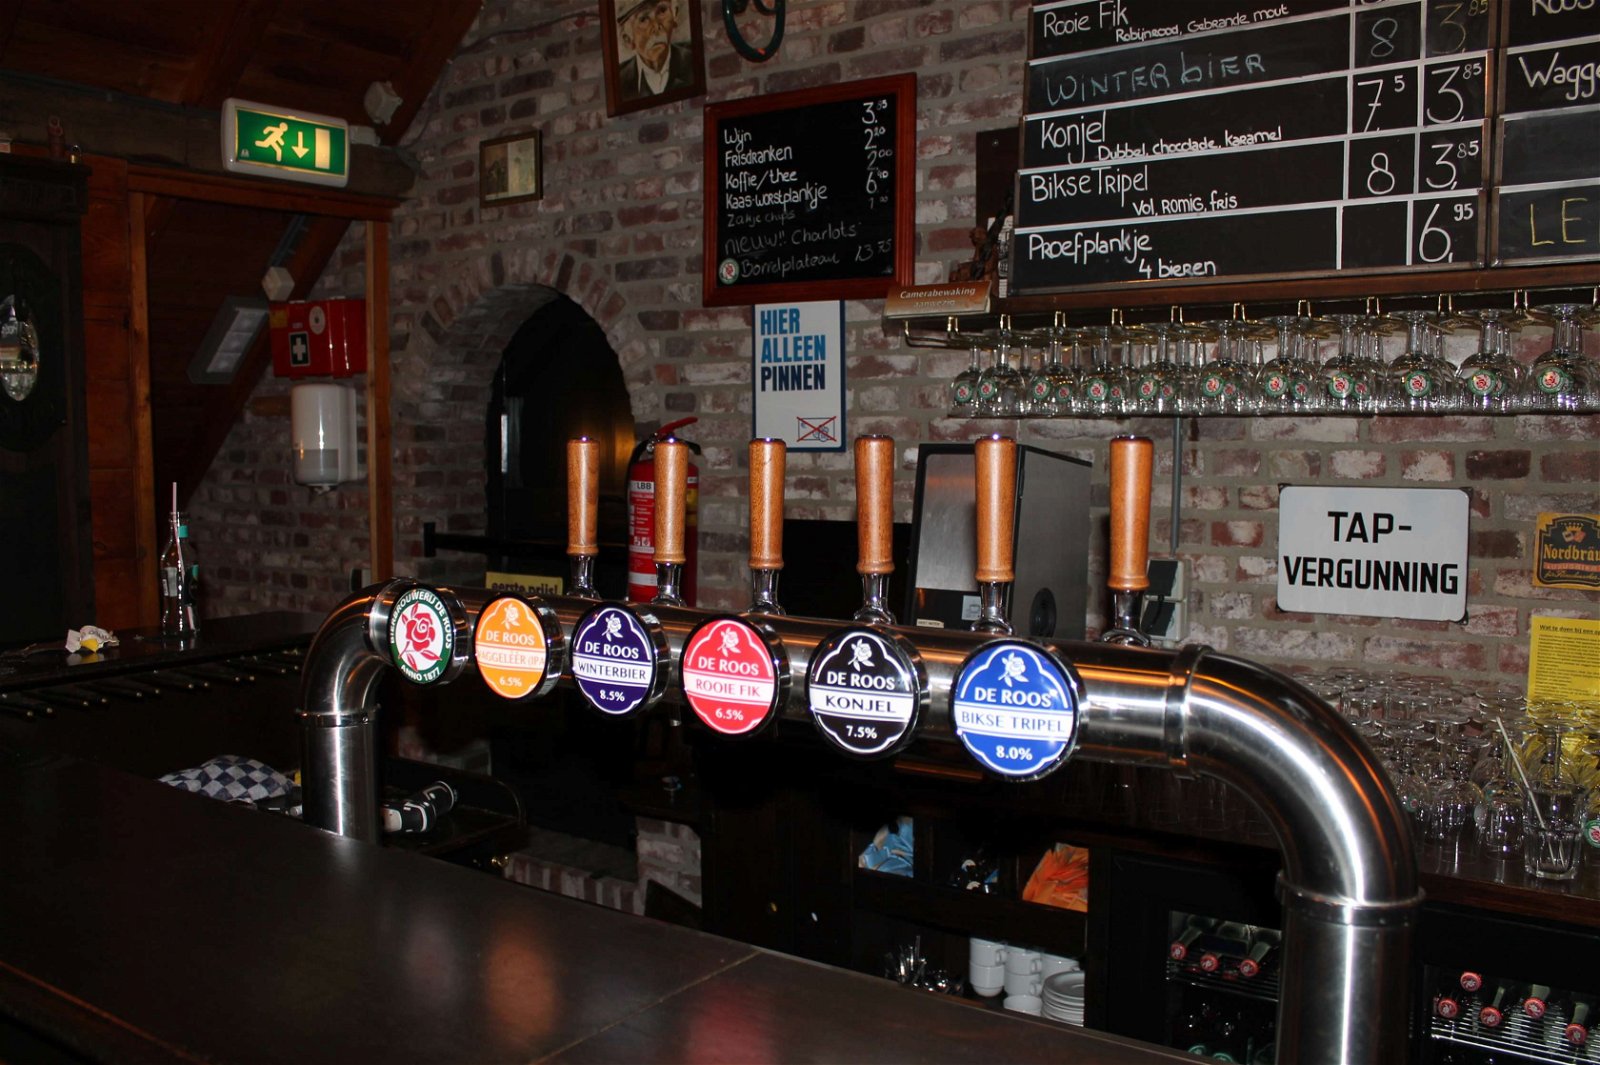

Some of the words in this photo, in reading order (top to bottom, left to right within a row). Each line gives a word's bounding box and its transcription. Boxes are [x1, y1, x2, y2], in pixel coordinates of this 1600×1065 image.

[1043, 12, 1091, 38] Rooie
[1099, 0, 1129, 29] Fik
[1253, 4, 1289, 22] mout
[1370, 17, 1399, 58] 8
[724, 127, 752, 153] Wijn
[1041, 110, 1107, 165] Konjel
[1097, 142, 1149, 161] Dubbel,
[1225, 125, 1282, 147] karamel
[725, 144, 793, 168] Frisdranken
[1031, 172, 1091, 202] Bikse
[1090, 164, 1149, 208] Tripel
[1366, 152, 1396, 195] 8
[1210, 190, 1238, 212] fris
[1029, 228, 1153, 265] Proefplankje
[1139, 258, 1152, 280] 4
[1158, 258, 1217, 278] bieren
[900, 287, 976, 299] Camerabewaking
[760, 307, 801, 336] HIER
[761, 334, 826, 364] ALLEEN
[760, 363, 826, 392] PINNEN
[1328, 511, 1412, 543] TAP-
[1283, 555, 1458, 595] VERGUNNING
[434, 600, 446, 617] DE
[442, 617, 452, 649] ROOS
[486, 630, 500, 642] DE
[502, 632, 535, 646] ROOS
[584, 641, 600, 655] DE
[603, 644, 639, 659] ROOS
[400, 665, 423, 682] ANNO
[423, 667, 440, 682] 1877
[578, 661, 646, 680] WINTERBIER
[698, 656, 715, 671] DE
[719, 659, 759, 676] ROOS
[499, 676, 523, 687] 6.5%
[696, 679, 735, 695] ROOIE
[740, 684, 760, 697] FIK
[827, 670, 846, 686] DE
[850, 673, 895, 691] ROOS
[600, 689, 625, 702] 8.5%
[825, 695, 897, 714] KONJEL
[974, 687, 997, 704] DE
[1001, 690, 1052, 708] ROOS
[715, 708, 744, 721] 6.5%
[961, 711, 1004, 728] BIKSE
[1012, 716, 1065, 733] TRIPEL
[846, 725, 877, 739] 7.5%
[996, 745, 1033, 760] 8.0%
